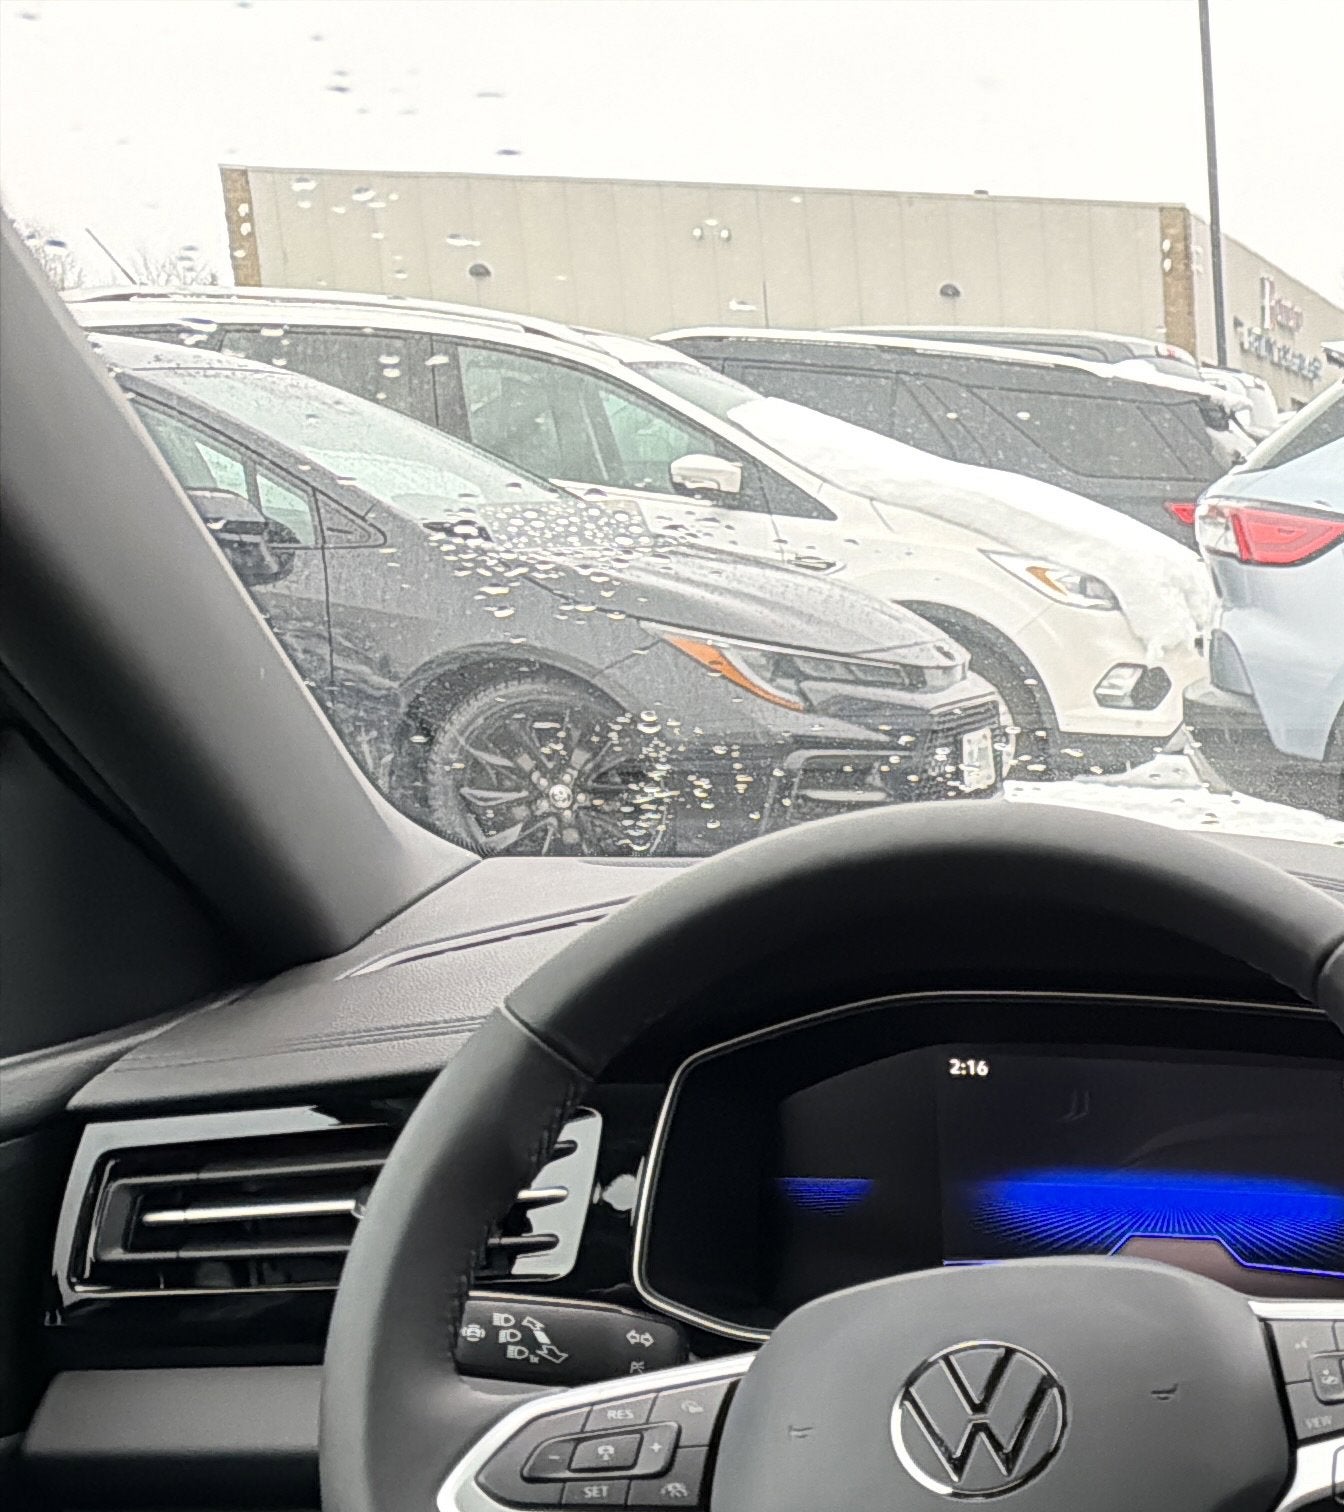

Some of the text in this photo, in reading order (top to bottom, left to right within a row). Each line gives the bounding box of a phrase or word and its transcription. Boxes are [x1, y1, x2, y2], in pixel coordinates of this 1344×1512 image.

[949, 1058, 989, 1076] 2:16
[606, 1409, 634, 1420] RES
[583, 1486, 609, 1499] SET
